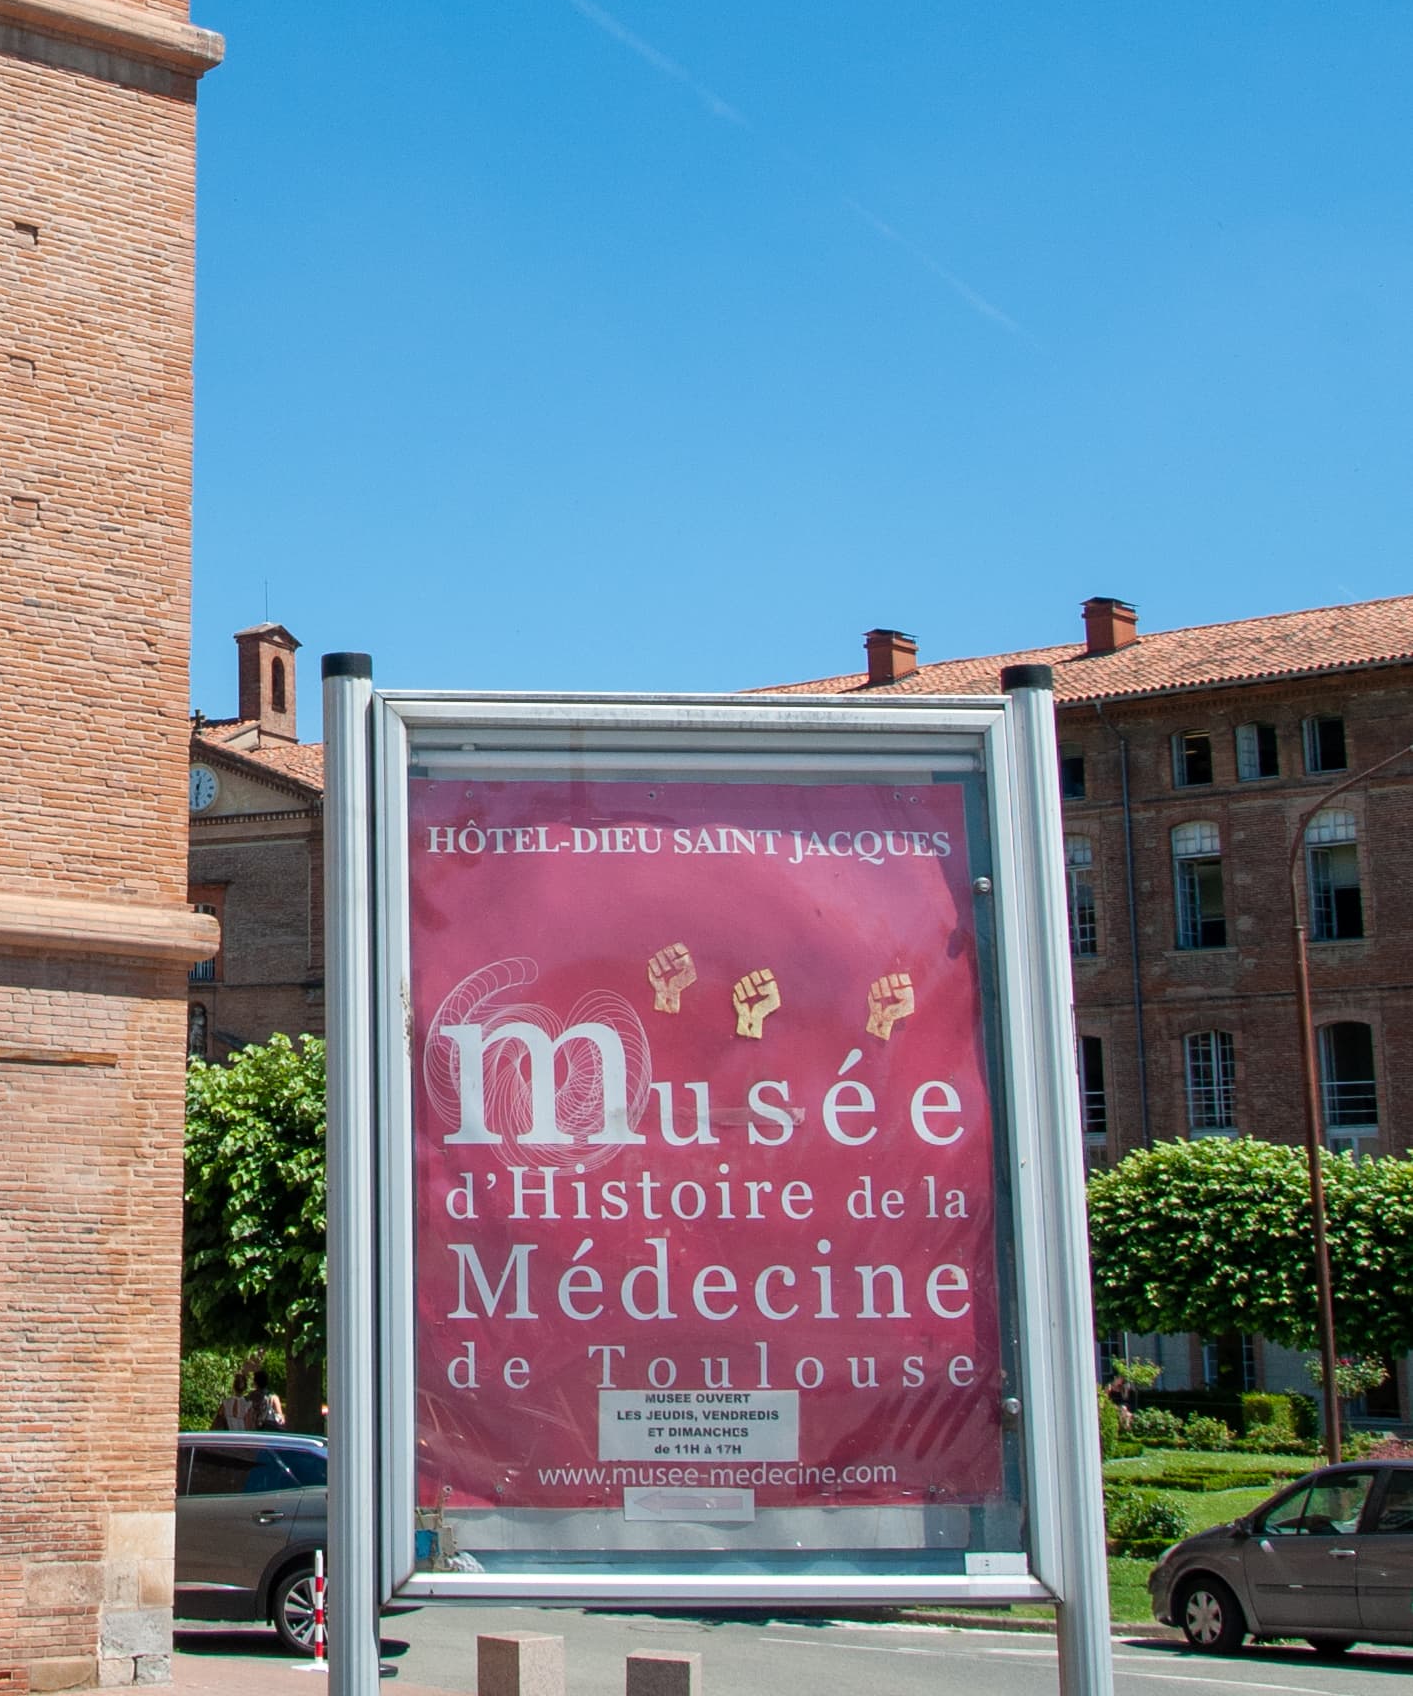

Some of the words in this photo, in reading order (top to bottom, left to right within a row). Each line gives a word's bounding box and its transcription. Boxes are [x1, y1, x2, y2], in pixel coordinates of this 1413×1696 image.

[427, 819, 663, 855] HÔTEL-DIEU
[673, 827, 782, 855] SAINT
[788, 829, 951, 865] JACQUES
[439, 1021, 965, 1147] musée
[445, 1162, 814, 1221] d'Histoire
[846, 1175, 906, 1220] de
[924, 1175, 969, 1220] la
[447, 1237, 971, 1321] Médecine
[447, 1341, 531, 1389] de
[587, 1341, 975, 1390] Toulouse
[617, 1410, 641, 1421] LES
[646, 1410, 698, 1422] JEUDIS,
[702, 1410, 780, 1421] VENDREDIS
[645, 1393, 691, 1404] MUSEE
[695, 1393, 751, 1404] OUVERT
[648, 1427, 664, 1438] ET
[668, 1427, 749, 1438] DIMANCHES
[654, 1443, 670, 1455] de
[675, 1444, 700, 1455] 11H
[704, 1443, 712, 1455] à
[717, 1444, 742, 1455] 17H
[538, 1461, 897, 1487] www.musee-medecine.com
